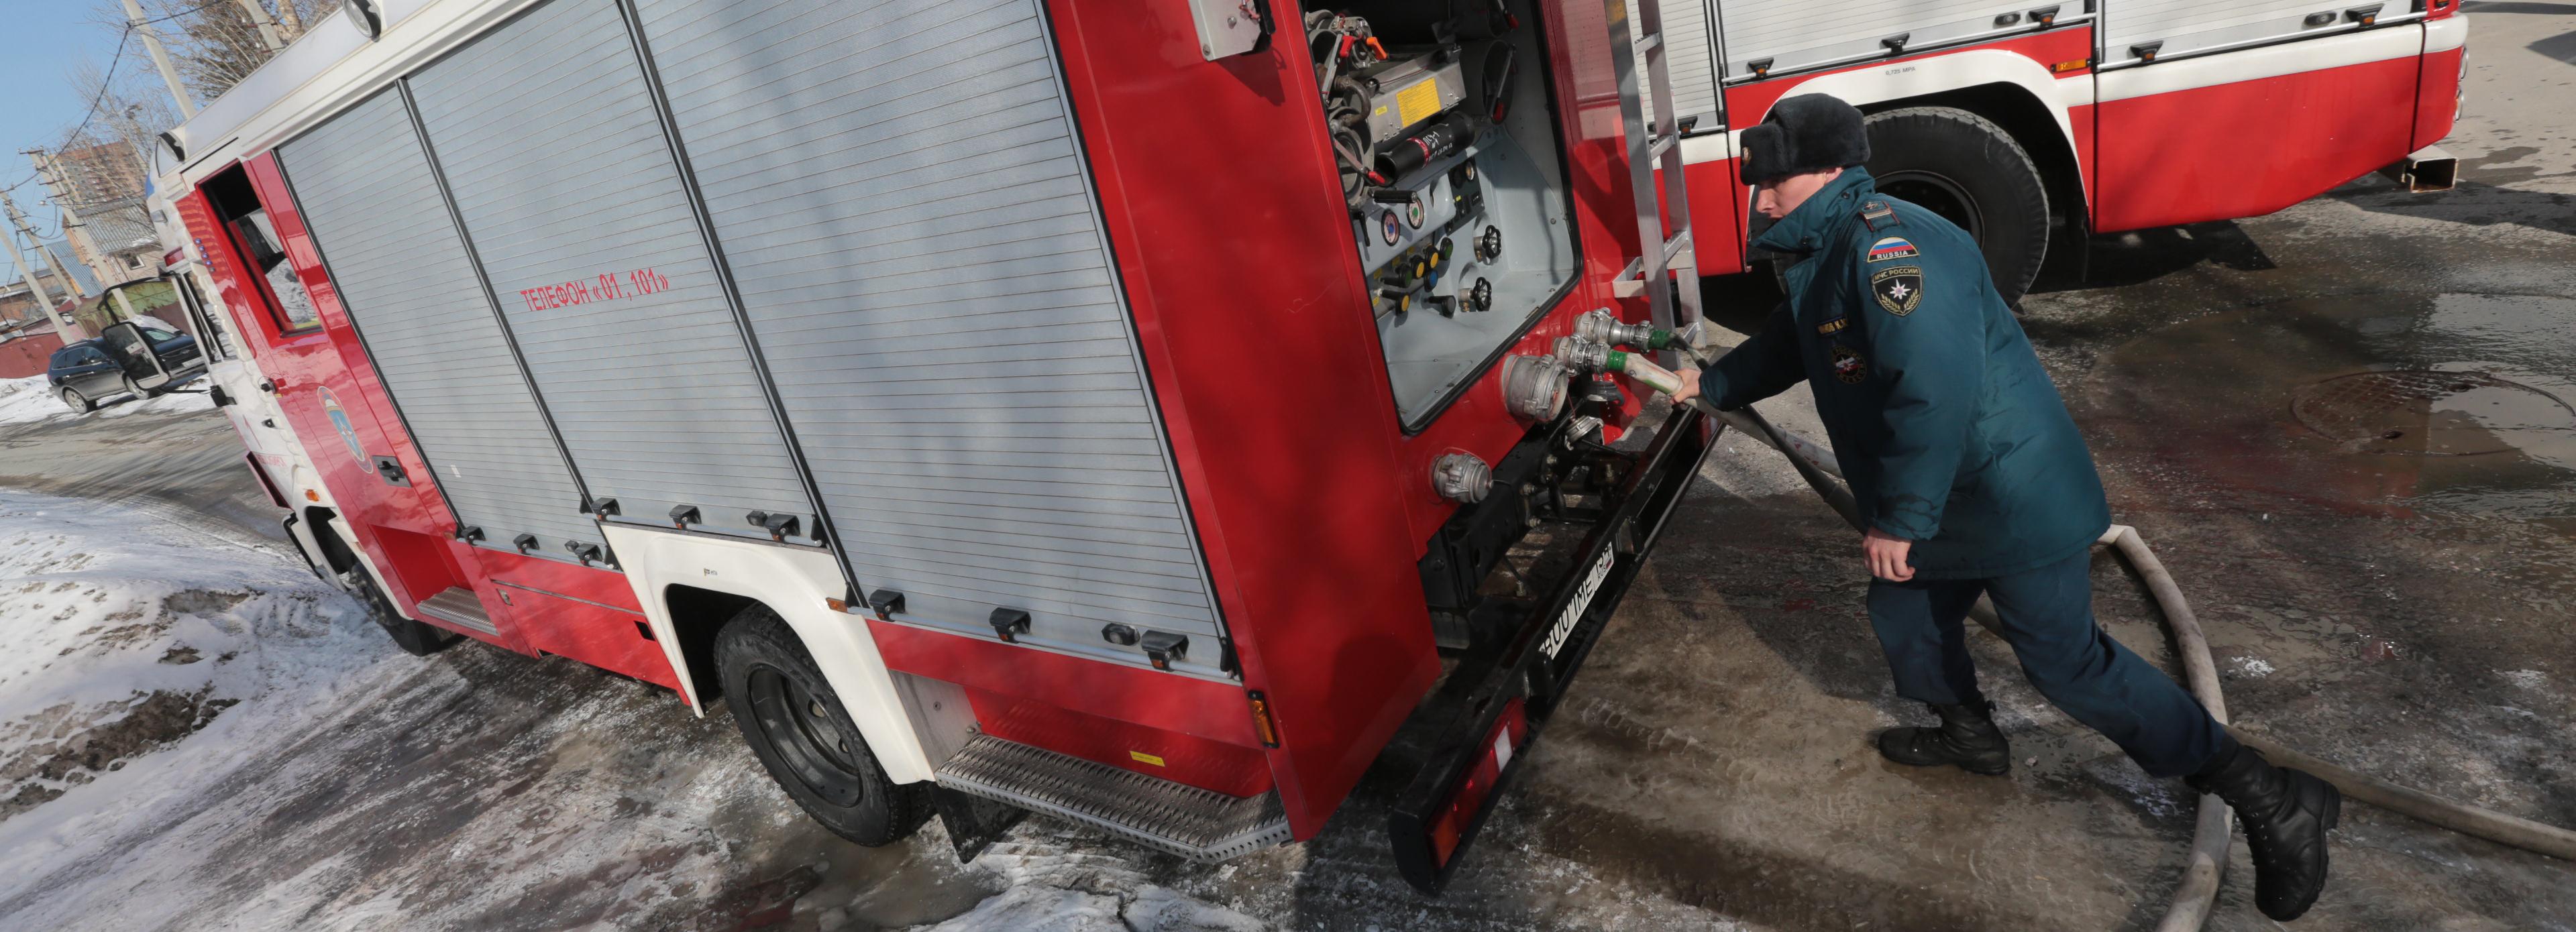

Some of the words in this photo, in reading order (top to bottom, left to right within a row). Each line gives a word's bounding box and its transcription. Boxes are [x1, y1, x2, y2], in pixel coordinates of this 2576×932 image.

[1876, 250, 1909, 259] RUSSIA
[1874, 272, 1888, 281] МЧС
[1888, 268, 1919, 276] РОССИИ
[520, 279, 592, 312] ТЕЛЕФОН
